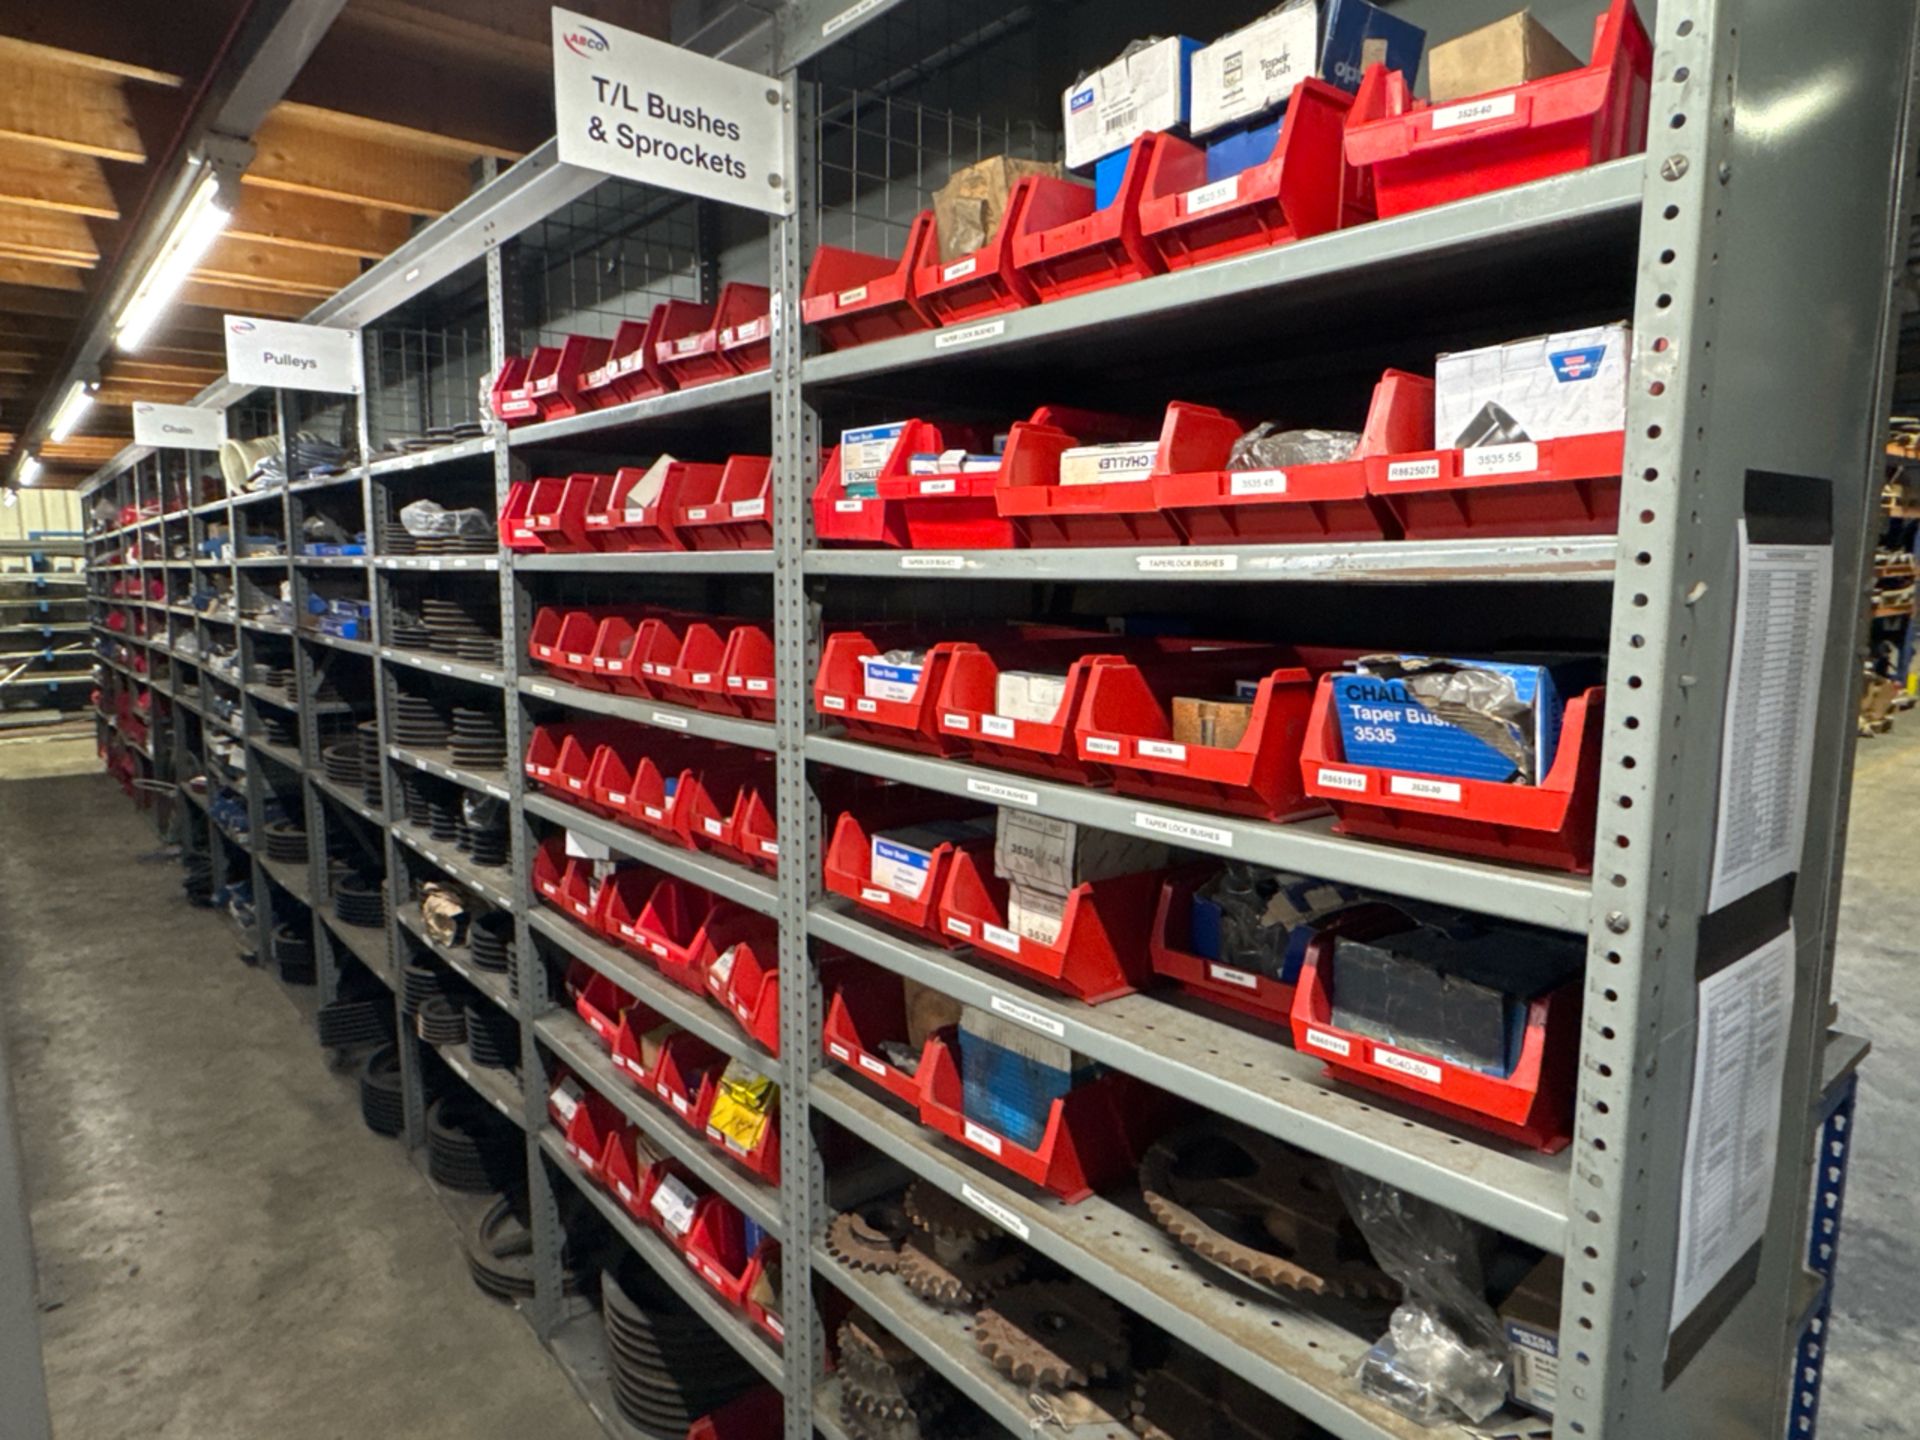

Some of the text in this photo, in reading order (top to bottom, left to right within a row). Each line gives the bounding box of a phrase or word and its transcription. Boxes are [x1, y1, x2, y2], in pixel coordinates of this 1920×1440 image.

[569, 33, 604, 52] ABCO
[1260, 53, 1290, 70] Taper
[1265, 63, 1291, 80] Bush
[592, 75, 741, 141] T/L Bushes
[588, 116, 747, 179] & Sprockets
[263, 352, 318, 370] Pulleys
[162, 424, 194, 435] Chain
[1349, 704, 1457, 728] Taper Bus
[1353, 725, 1397, 743] 3535
[1144, 817, 1168, 829] TAPER
[1168, 823, 1188, 834] LOCK
